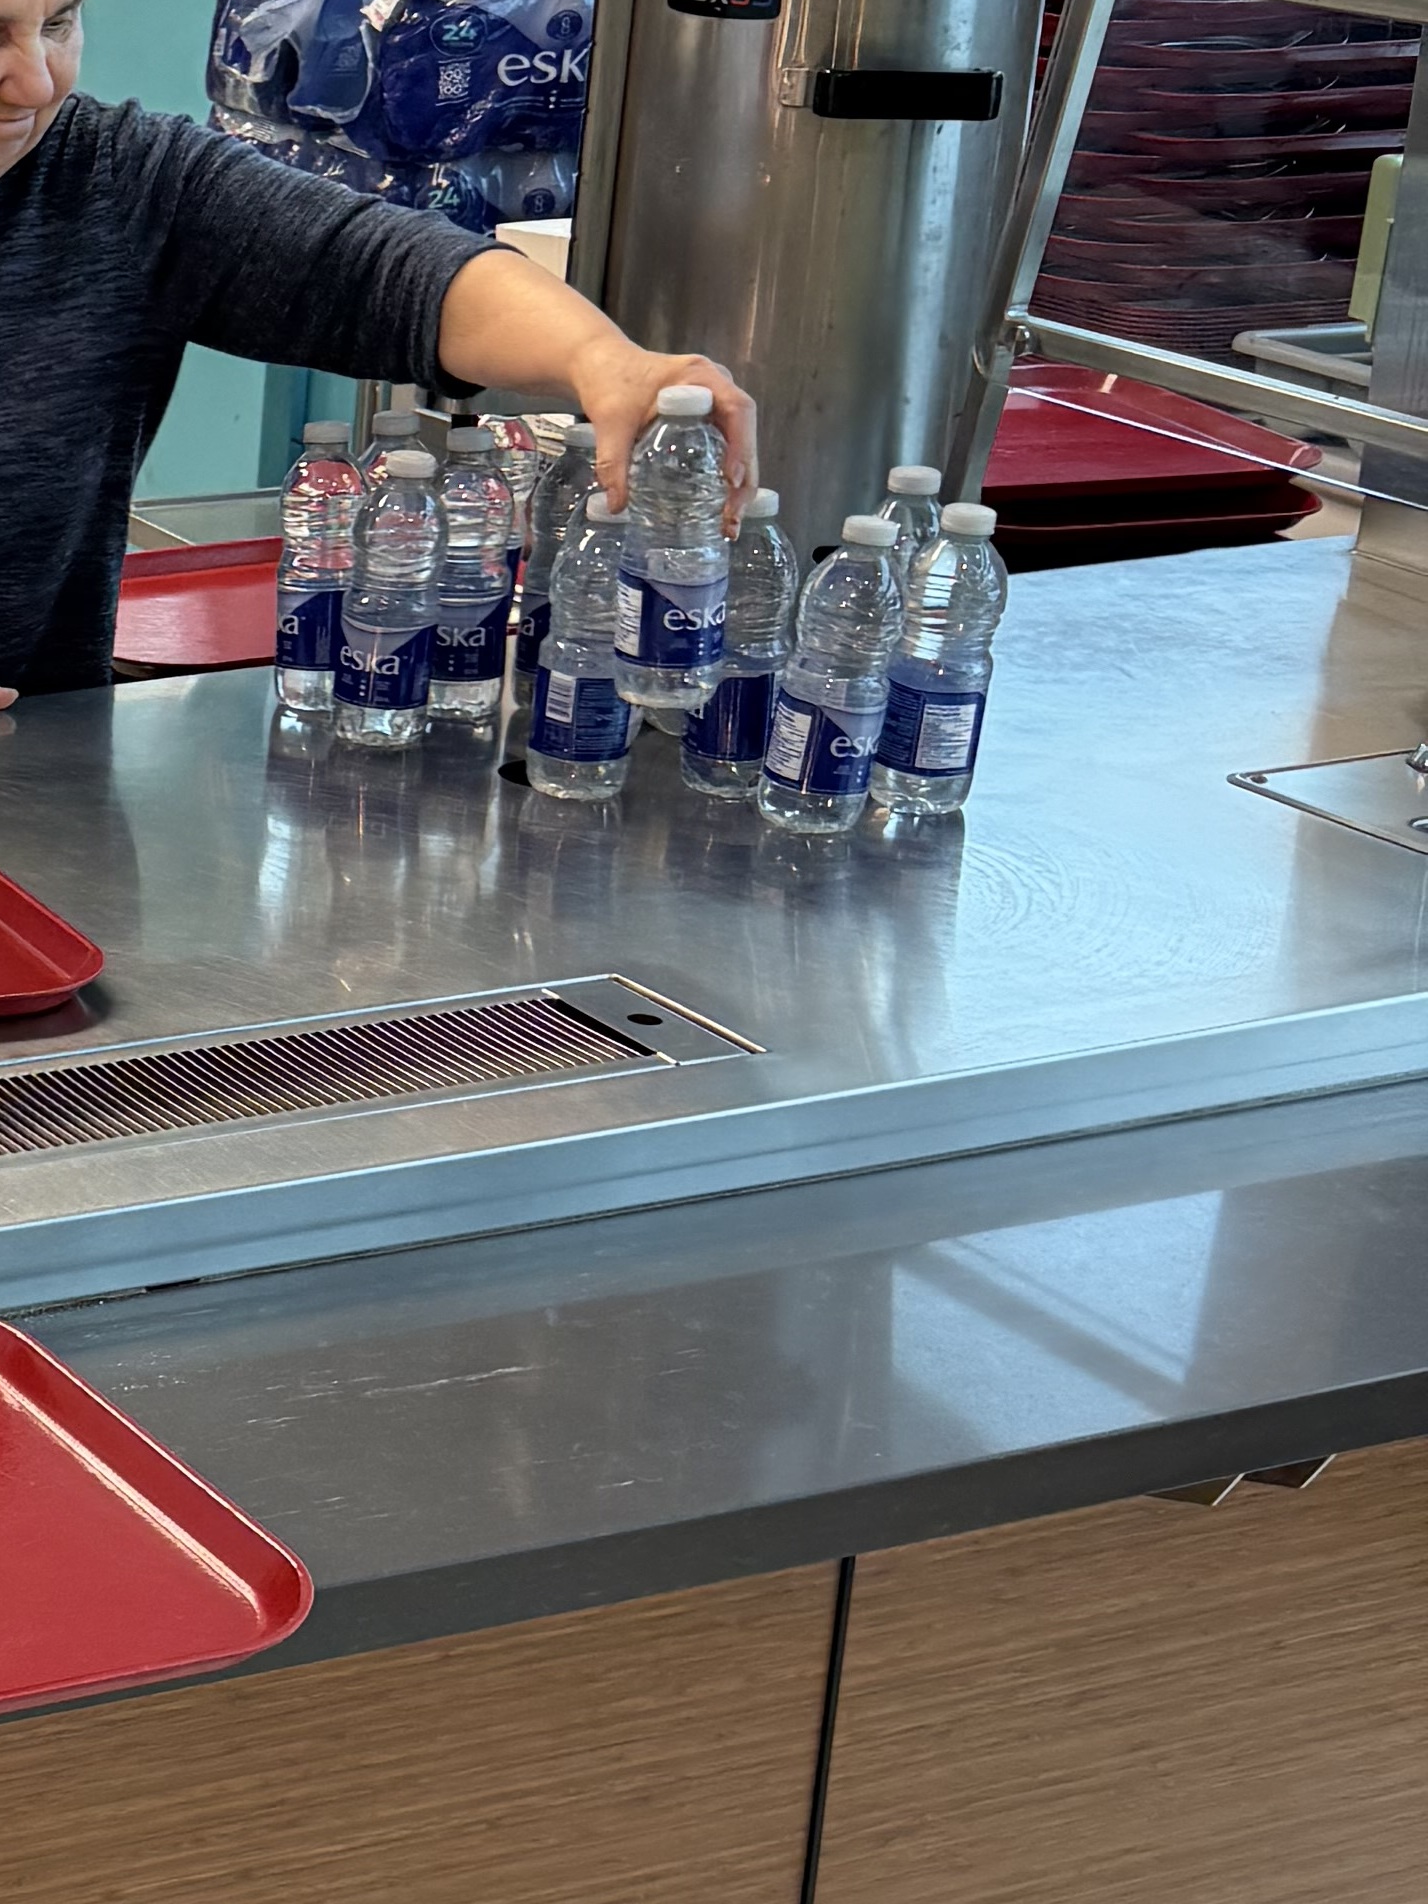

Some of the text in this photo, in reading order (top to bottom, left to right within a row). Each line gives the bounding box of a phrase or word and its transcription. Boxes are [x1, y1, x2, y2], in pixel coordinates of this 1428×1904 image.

[441, 17, 478, 42] 24
[496, 47, 590, 87] esk
[427, 186, 461, 209] 24
[435, 625, 487, 648] ska
[339, 645, 401, 676] eska
[829, 736, 880, 758] esk
